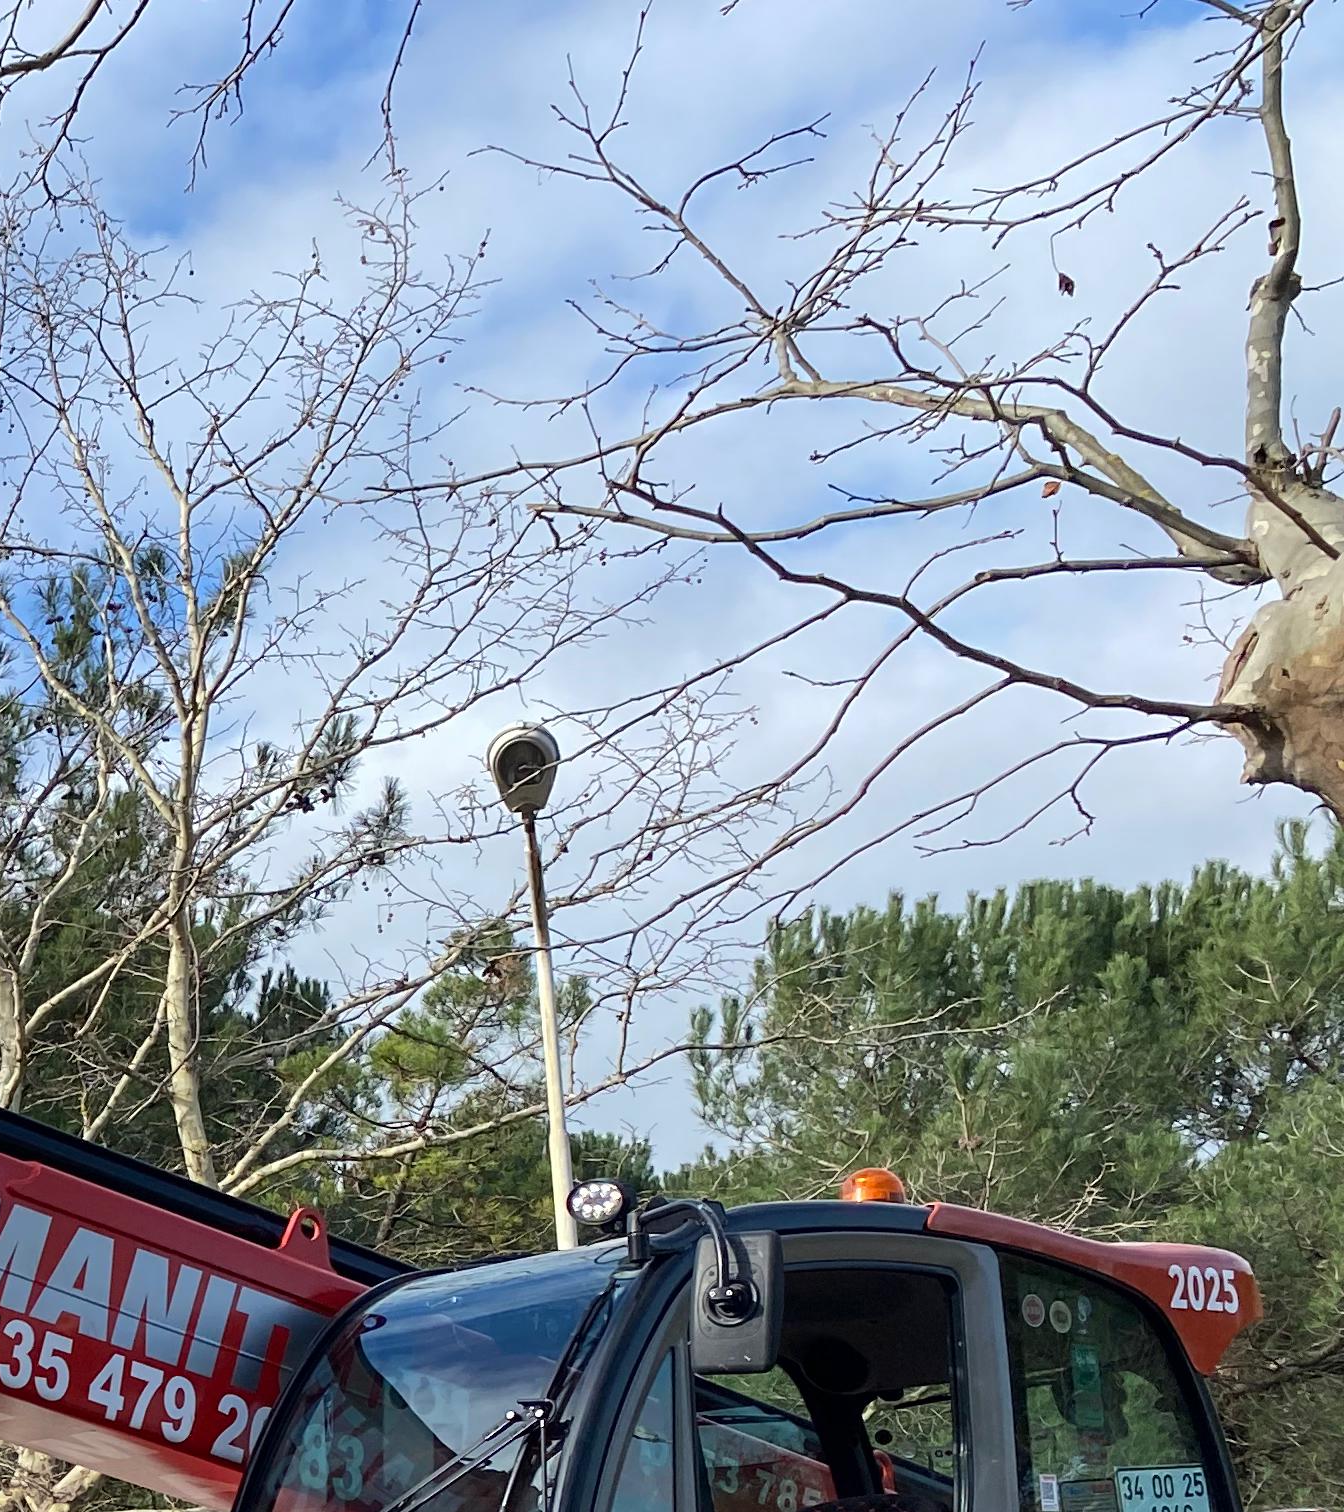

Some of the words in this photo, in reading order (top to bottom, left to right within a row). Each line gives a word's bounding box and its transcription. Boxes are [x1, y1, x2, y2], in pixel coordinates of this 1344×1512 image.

[1167, 1264, 1240, 1314] 2025
[87, 1353, 197, 1444] 479
[298, 1423, 365, 1501] 83
[1121, 1475, 1144, 1500] 34
[1151, 1474, 1175, 1499] 00
[1182, 1472, 1205, 1498] 25
